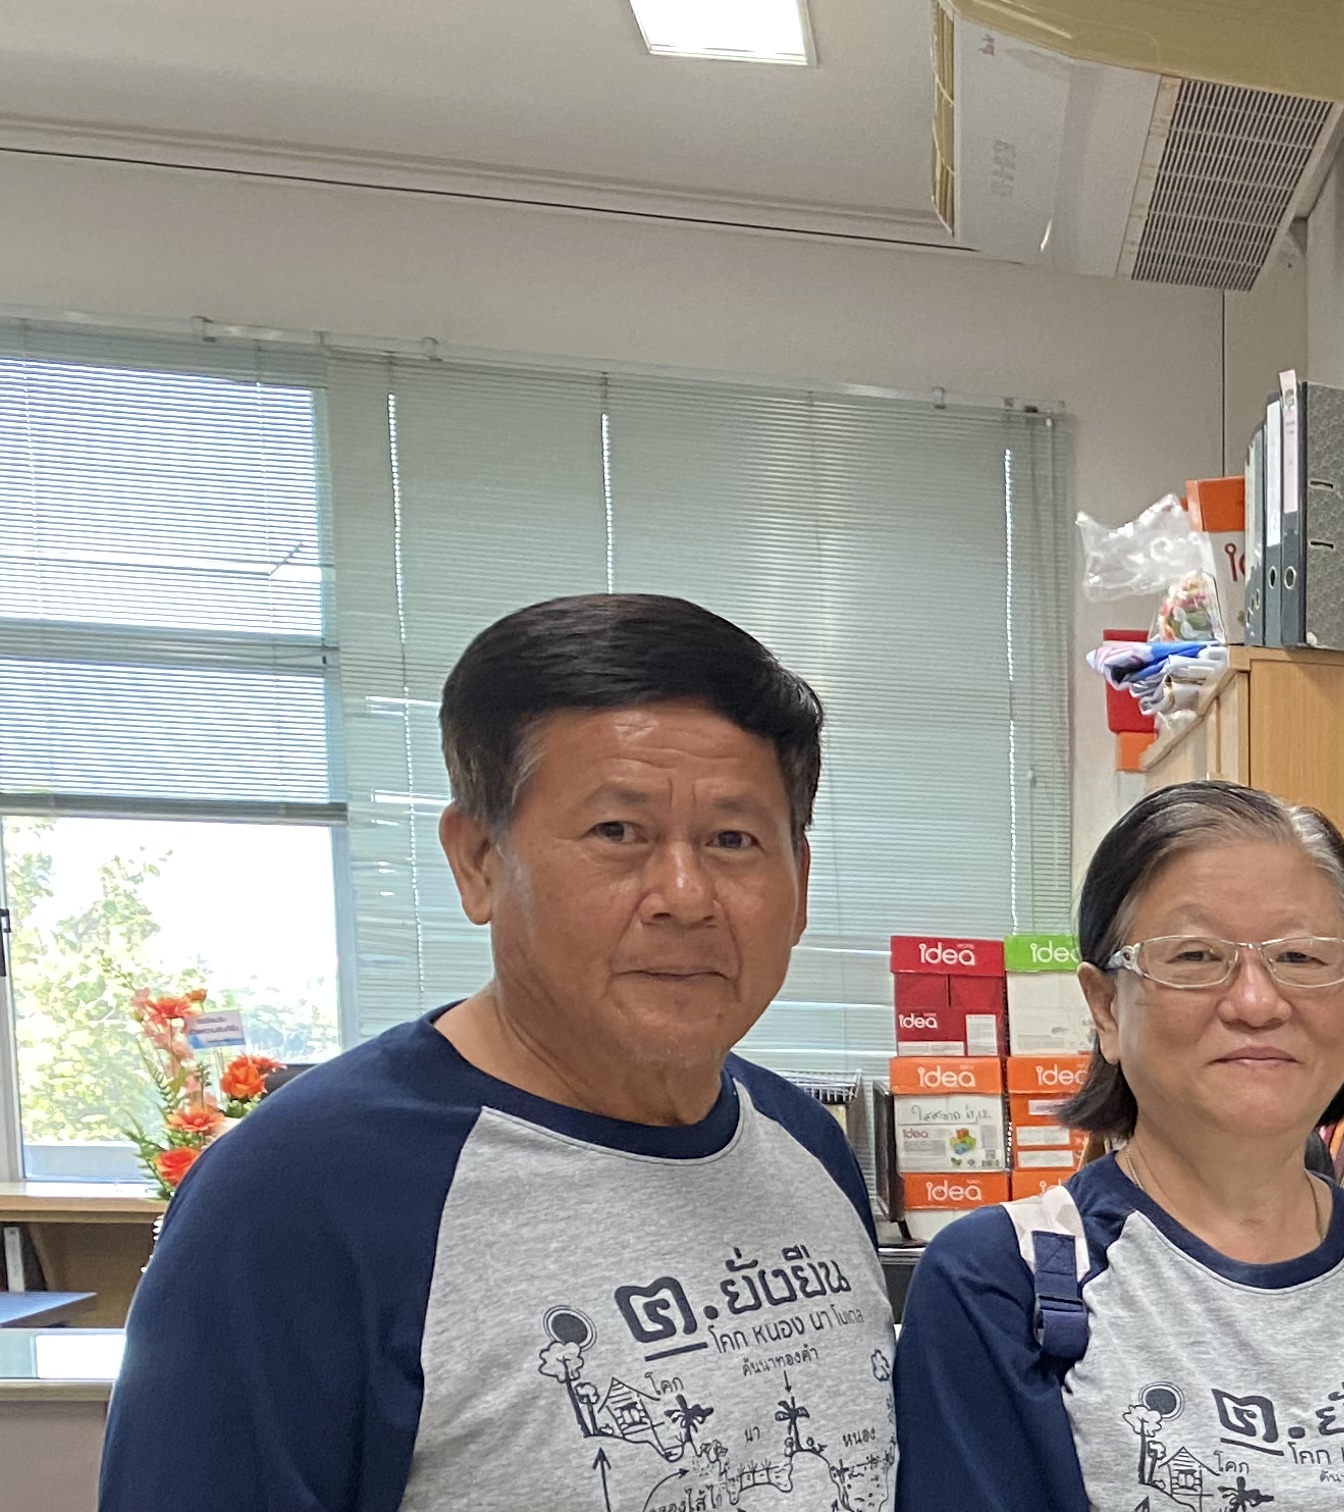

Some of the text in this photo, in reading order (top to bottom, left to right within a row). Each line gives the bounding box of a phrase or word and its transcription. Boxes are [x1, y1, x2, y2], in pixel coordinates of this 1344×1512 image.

[919, 942, 976, 966] idea
[899, 1013, 938, 1029] idea
[917, 1065, 976, 1088] idea
[902, 1128, 929, 1139] idea
[926, 1180, 983, 1201] idea
[707, 1325, 748, 1354] โคก
[751, 1316, 806, 1345] หนอง
[810, 1310, 834, 1331] นา
[644, 1371, 685, 1396] โคก
[744, 1427, 761, 1443] นา
[1213, 1450, 1250, 1474] โคก
[1287, 1441, 1332, 1465] โคก
